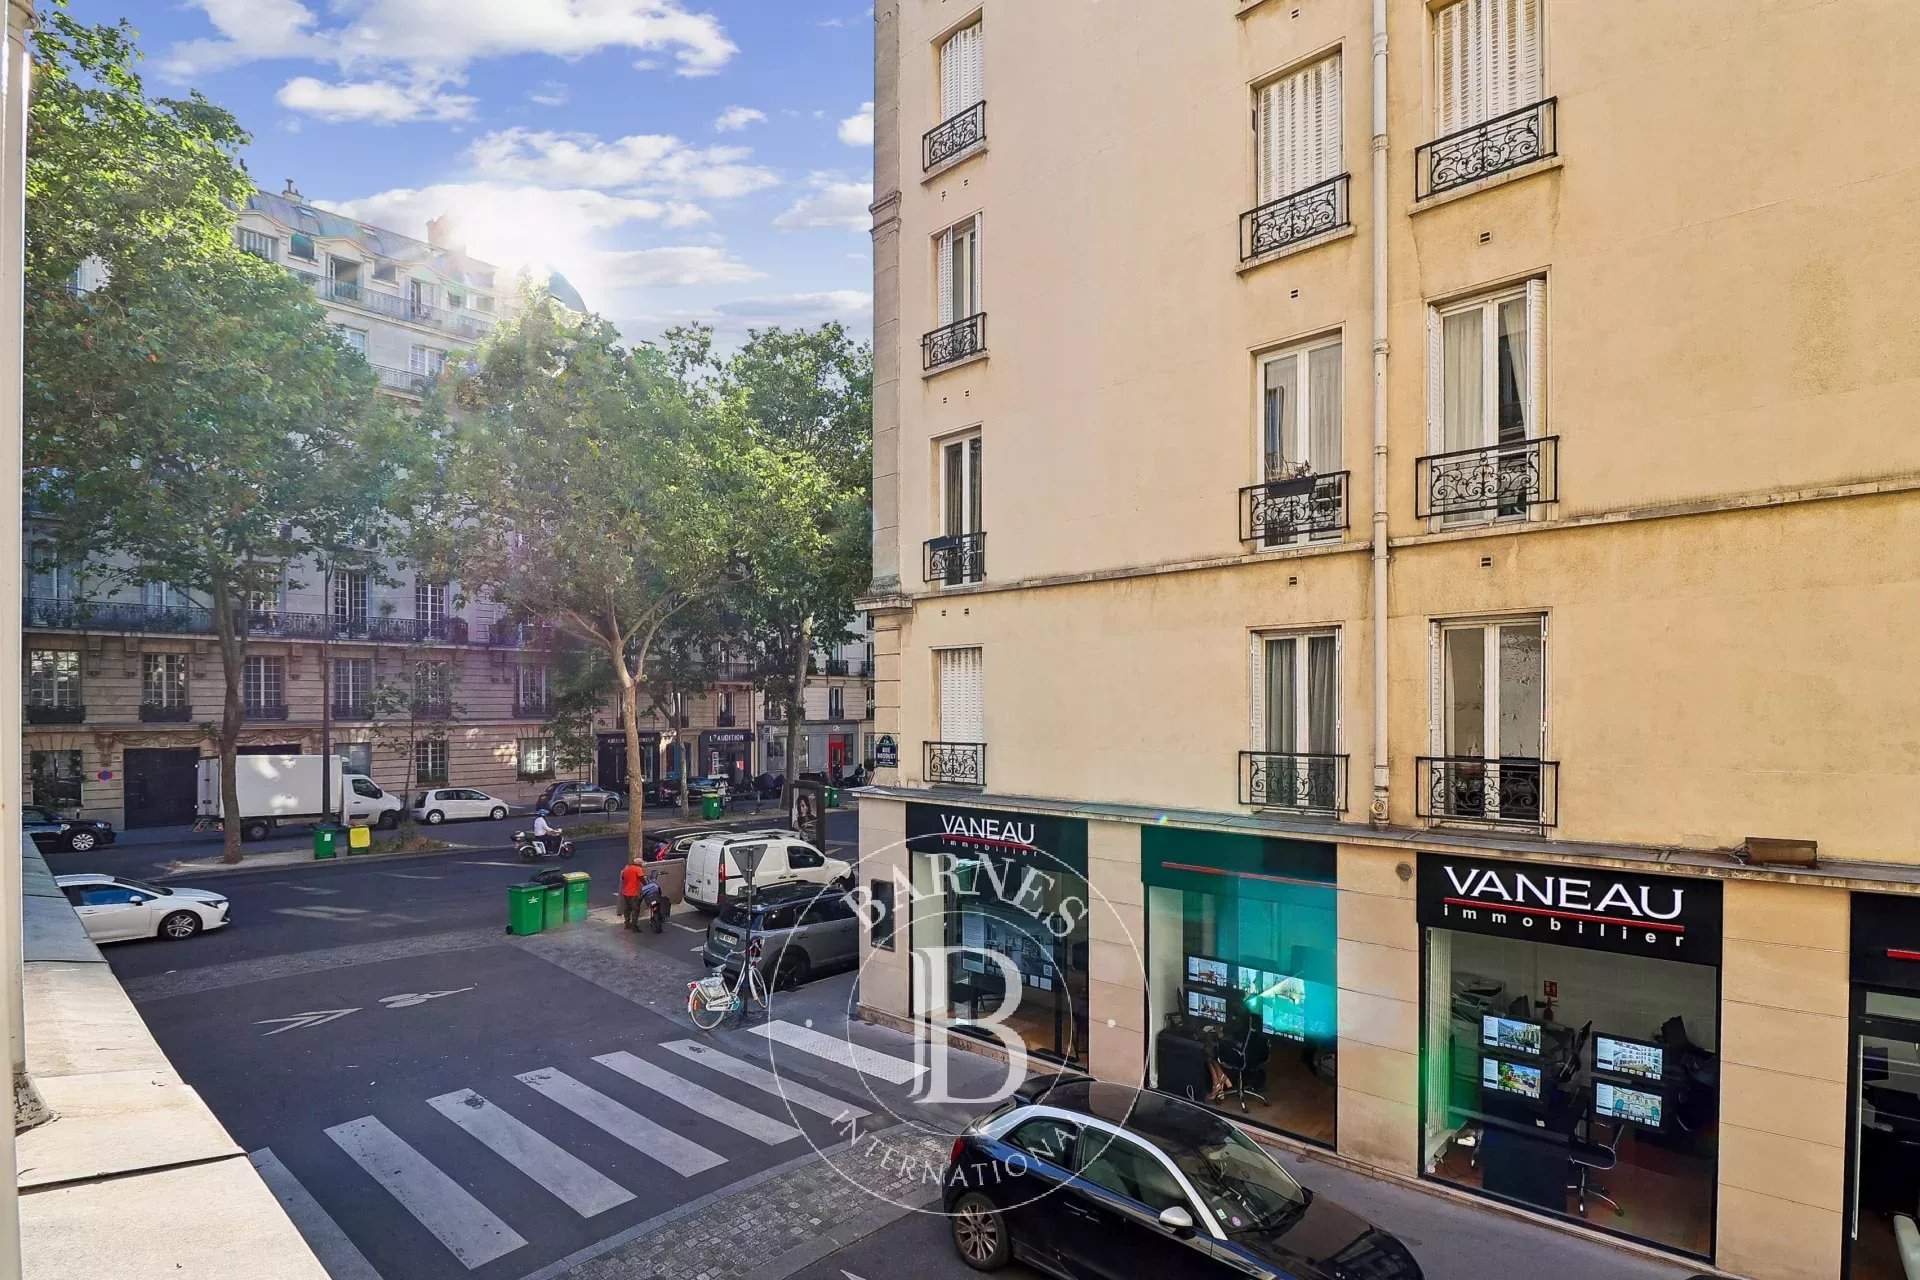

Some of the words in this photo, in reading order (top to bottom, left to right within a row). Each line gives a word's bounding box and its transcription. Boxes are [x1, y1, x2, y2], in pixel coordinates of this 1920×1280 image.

[940, 814, 1035, 845] VANEAU
[942, 837, 1038, 857] immobilier
[1443, 866, 1685, 920] VANEAU
[1443, 903, 1685, 947] immobilier
